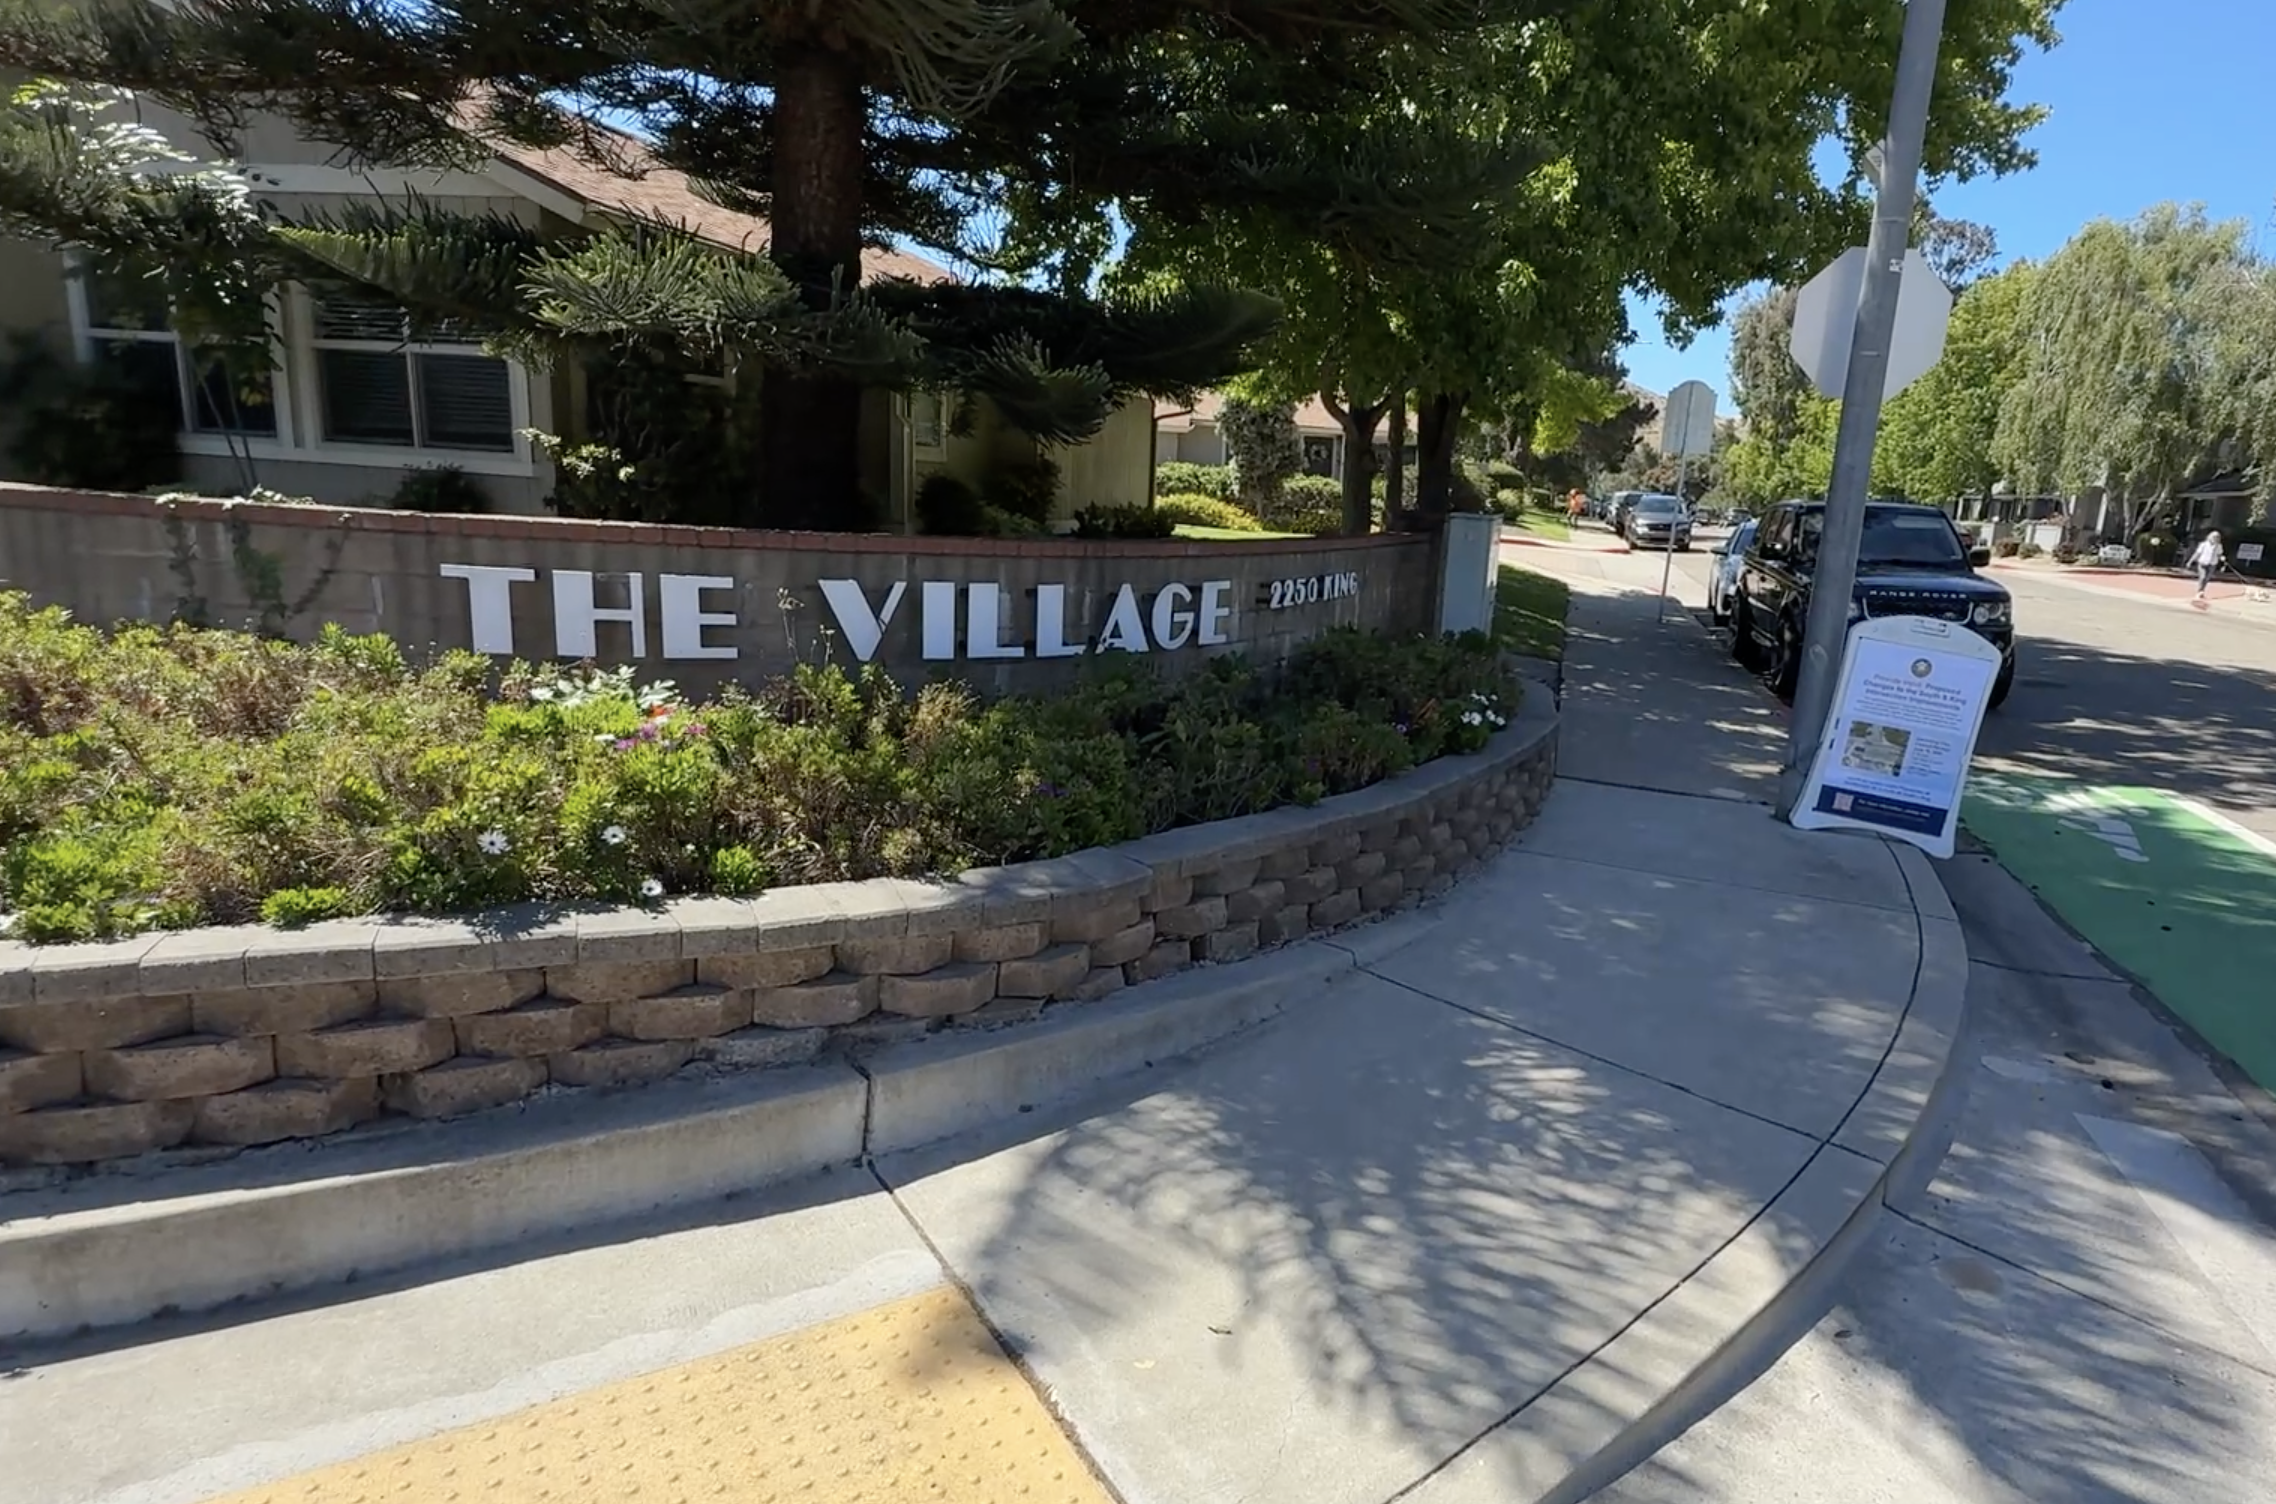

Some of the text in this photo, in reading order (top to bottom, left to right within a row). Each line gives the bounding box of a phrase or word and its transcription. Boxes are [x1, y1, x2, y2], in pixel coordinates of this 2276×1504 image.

[439, 562, 1232, 662] THE VILLAGE
[1269, 571, 1358, 610] 2250 KING
